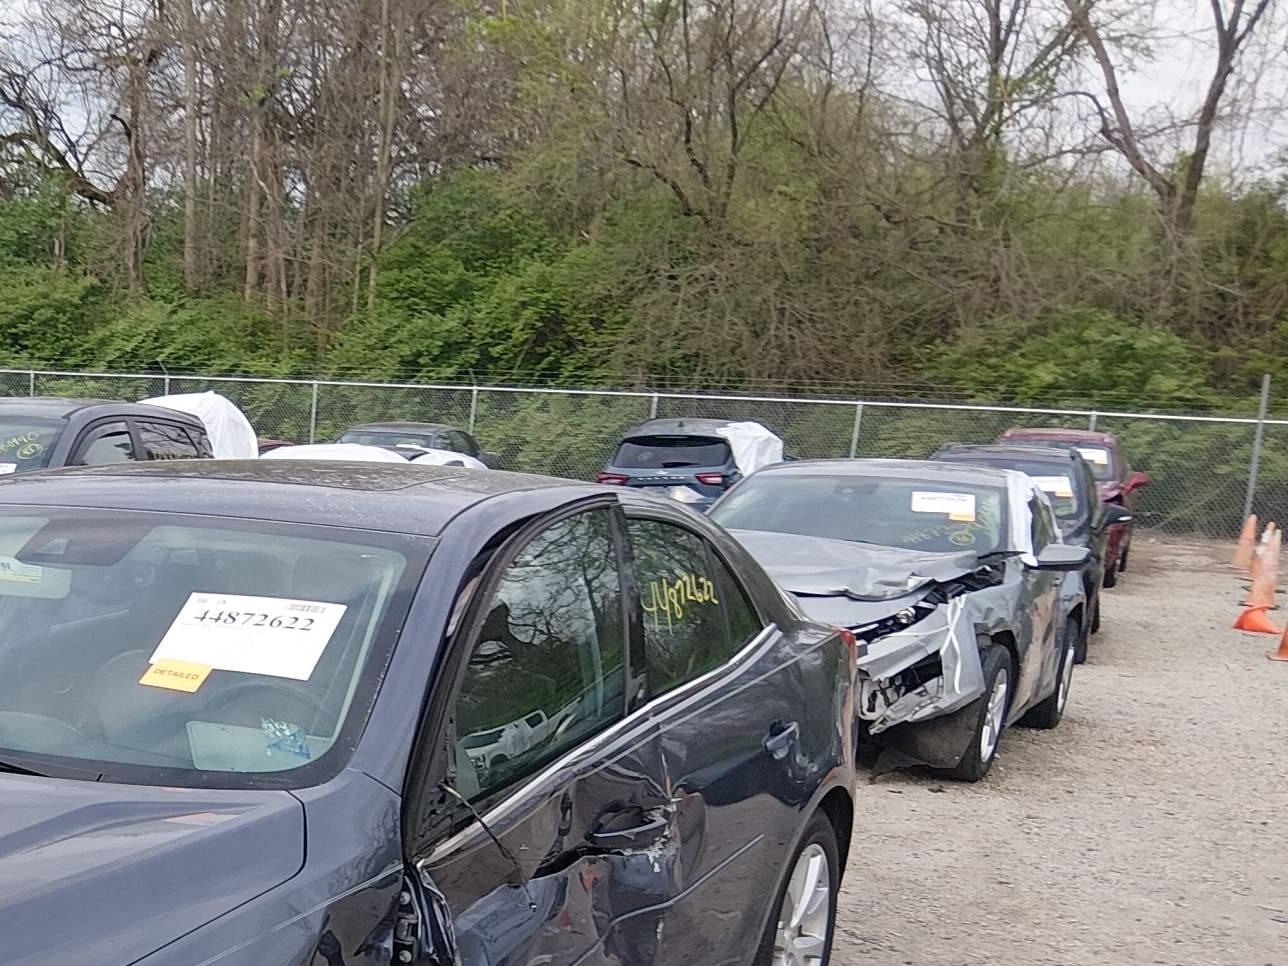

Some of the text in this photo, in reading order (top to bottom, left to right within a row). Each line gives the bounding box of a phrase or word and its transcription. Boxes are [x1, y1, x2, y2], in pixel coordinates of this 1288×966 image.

[640, 574, 719, 635] 44872622
[194, 610, 316, 631] 44872622
[153, 667, 200, 681] DETAILED
